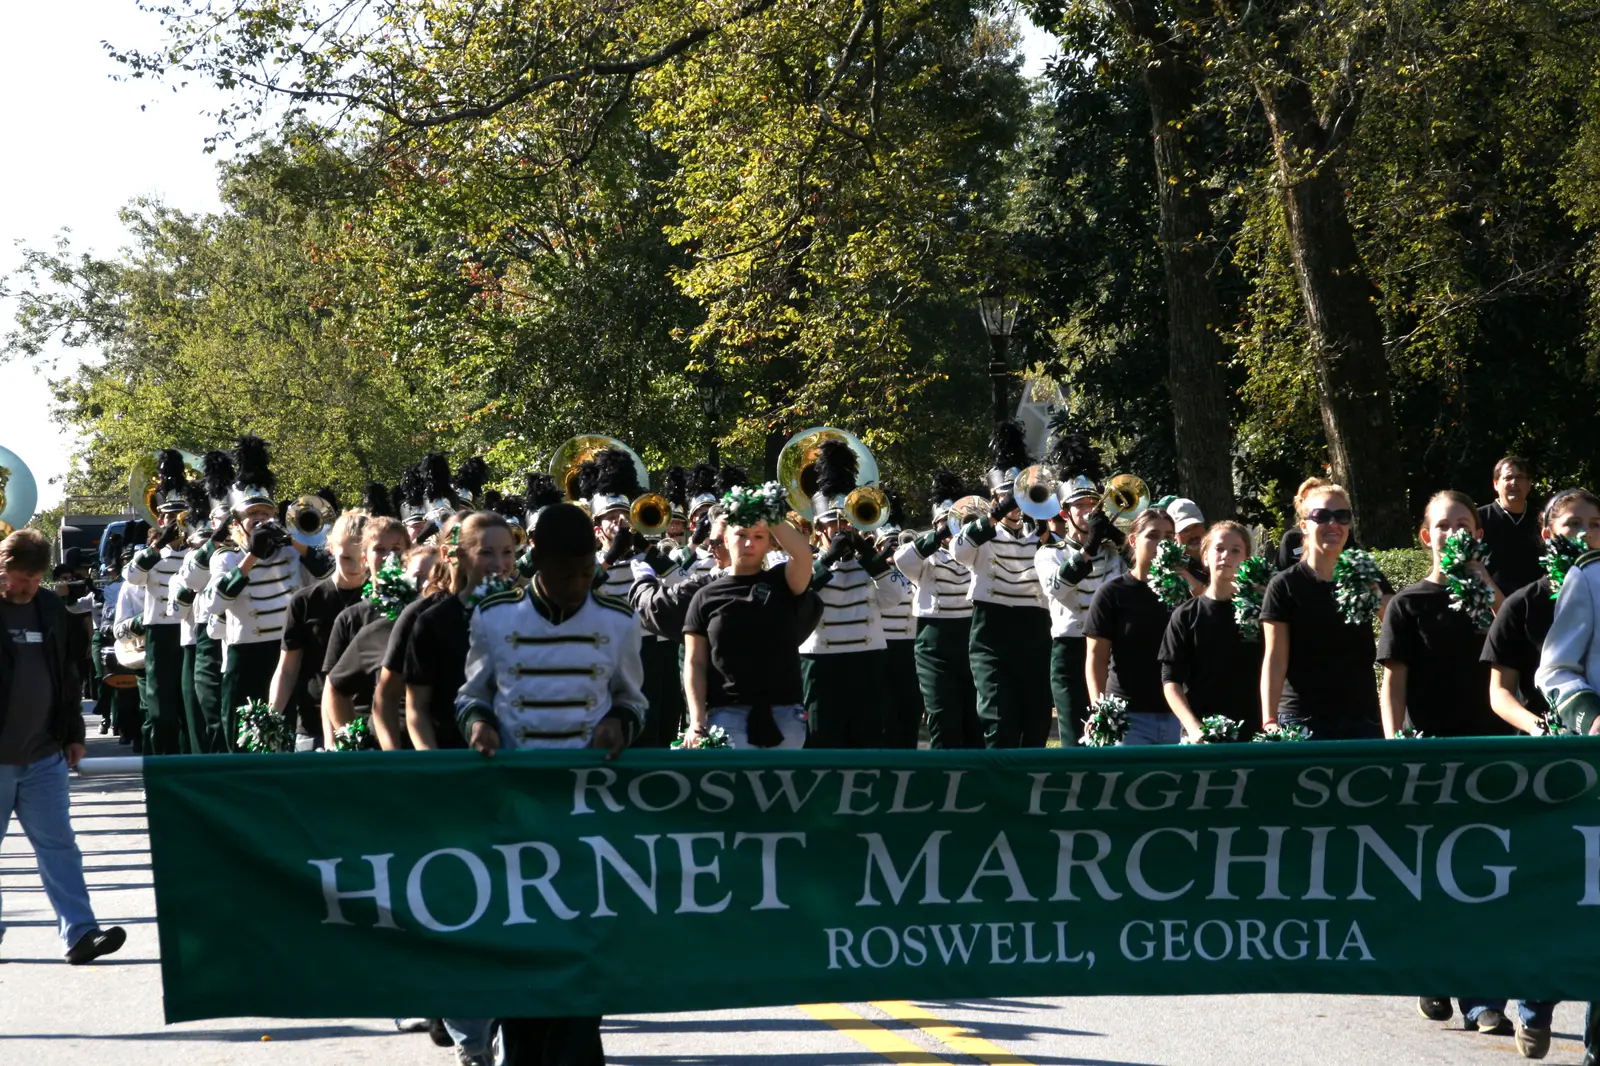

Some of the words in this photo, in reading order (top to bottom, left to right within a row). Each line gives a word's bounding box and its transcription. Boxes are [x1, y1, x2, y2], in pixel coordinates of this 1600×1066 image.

[571, 768, 987, 816] ROSWELL
[1027, 768, 1254, 816] HIGH
[1292, 758, 1600, 809] SCHOO
[307, 831, 807, 933] HORNET
[855, 822, 1518, 907] MARCHING
[824, 920, 1096, 971] ROSWELL,
[1118, 918, 1376, 962] GEORGIA
